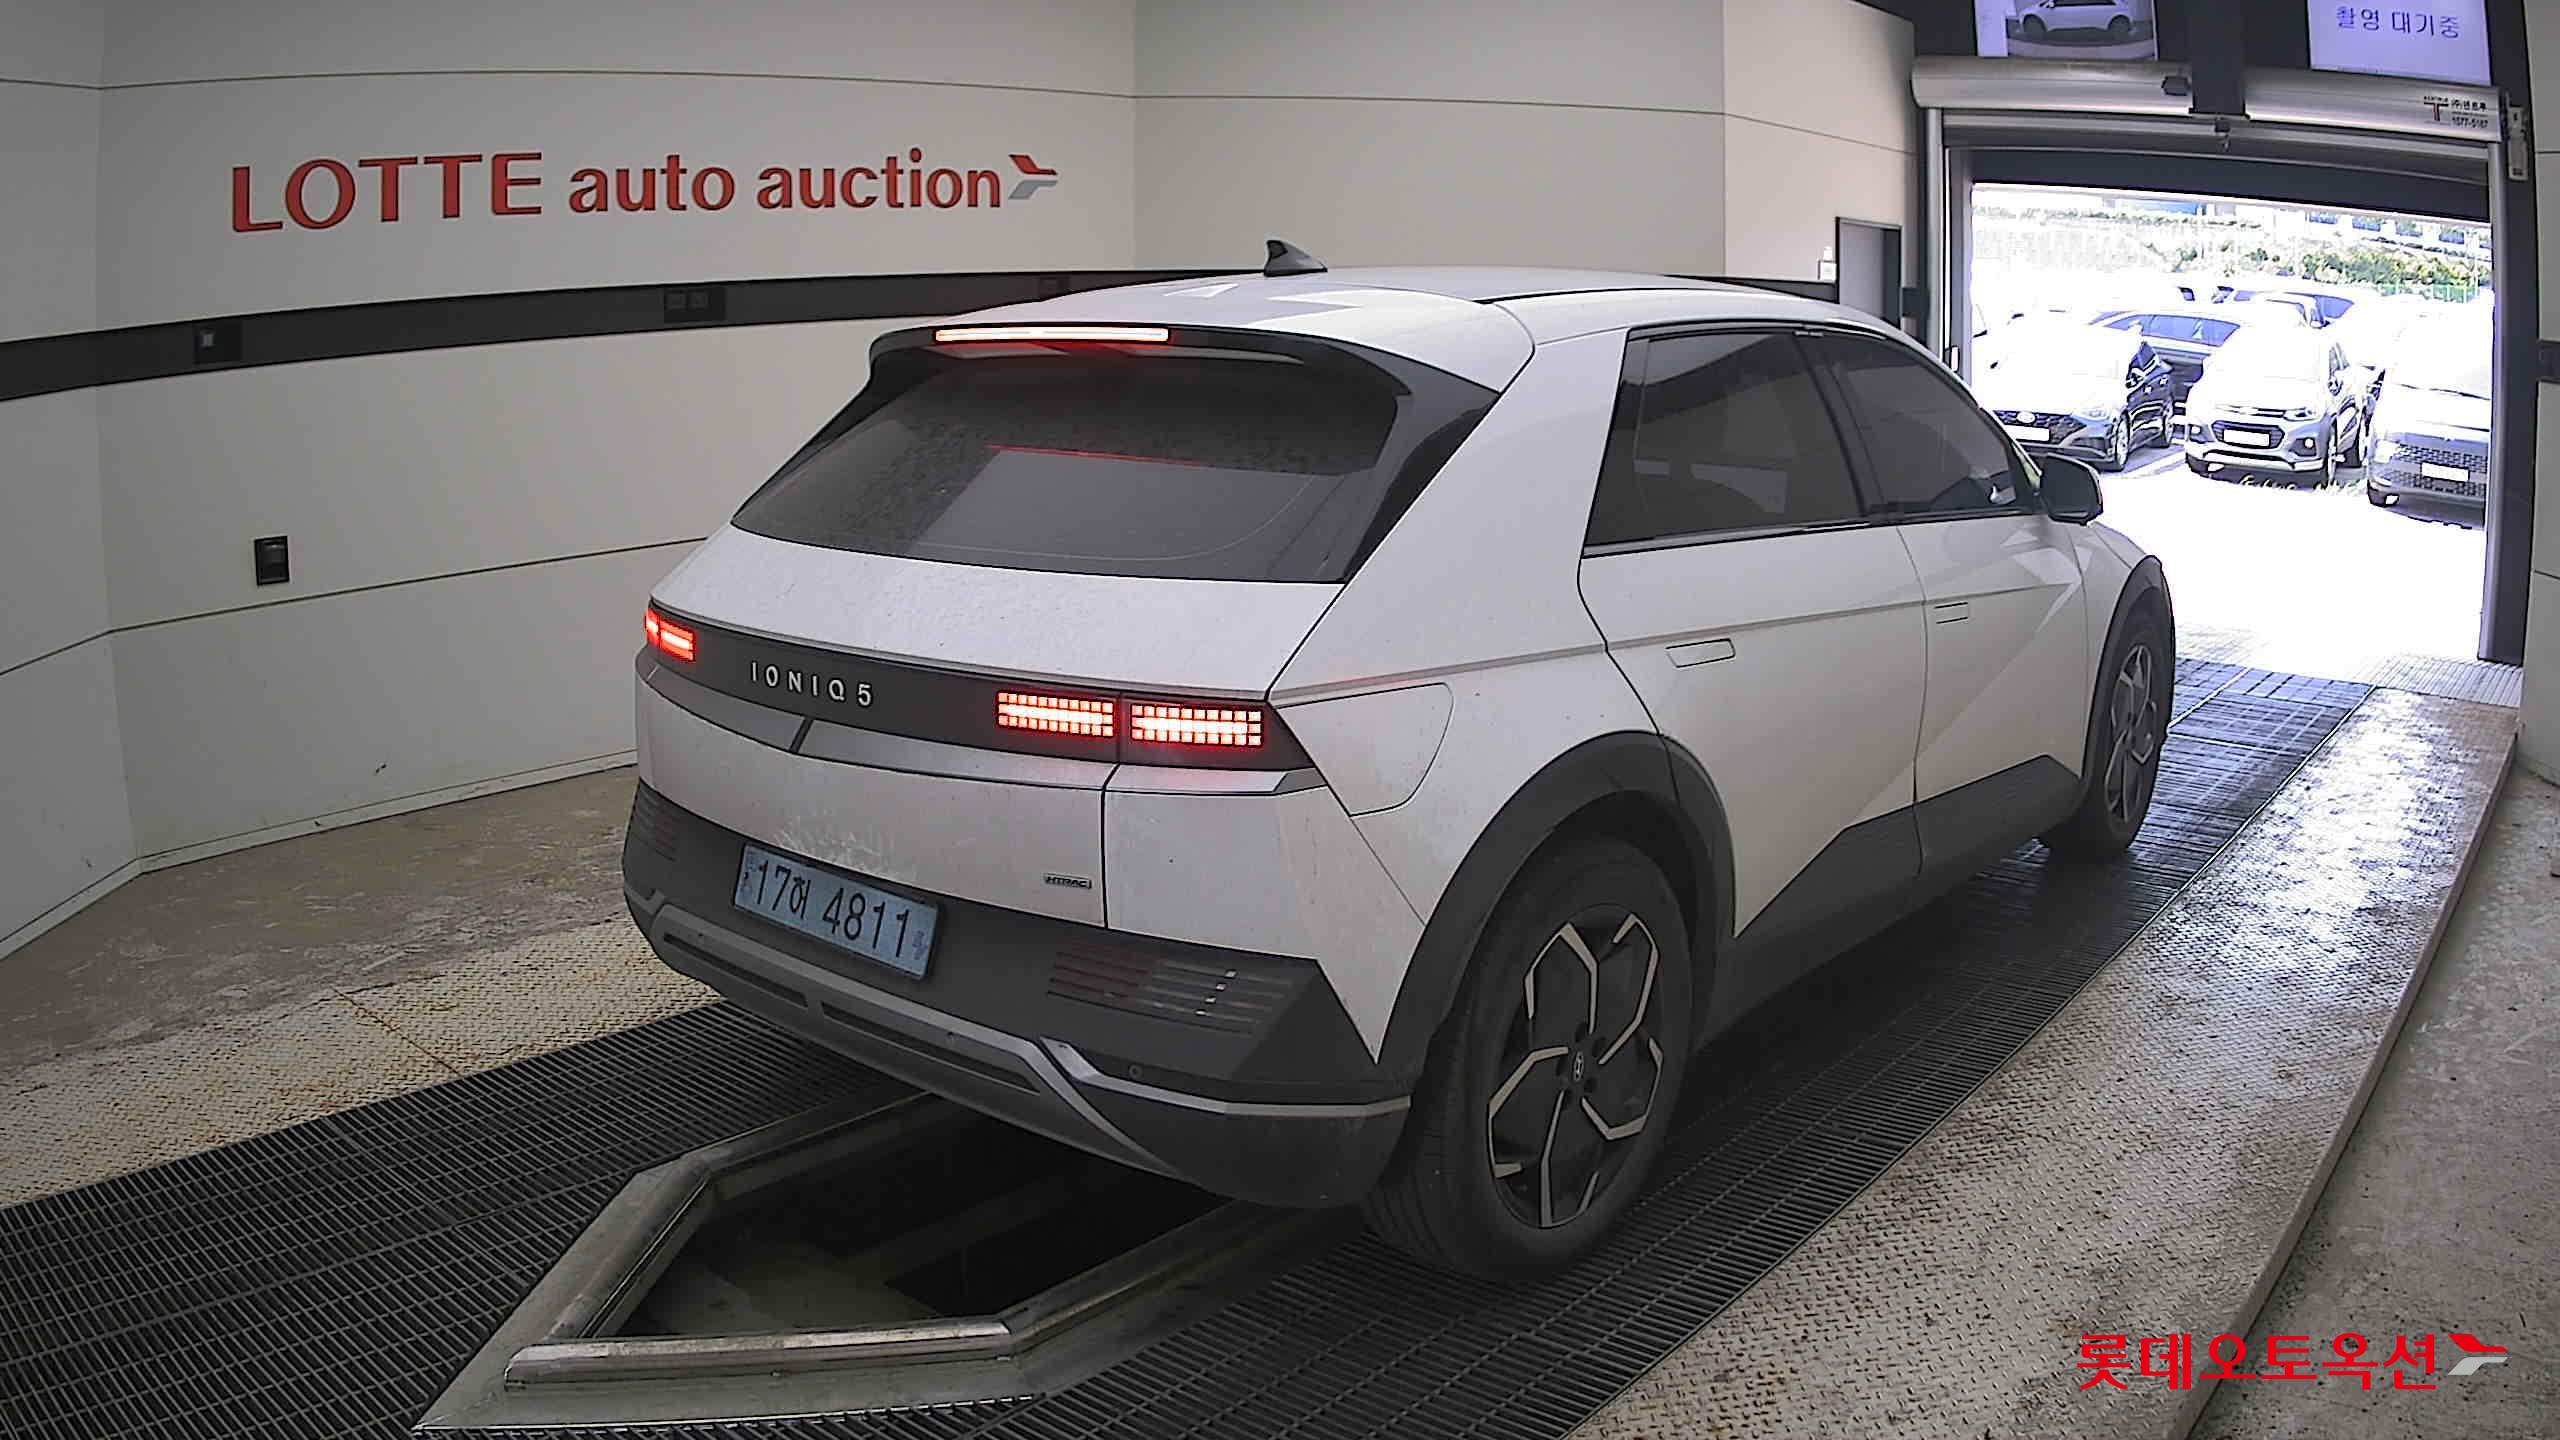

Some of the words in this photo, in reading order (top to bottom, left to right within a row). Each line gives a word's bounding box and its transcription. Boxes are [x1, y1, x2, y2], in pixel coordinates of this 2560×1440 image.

[2337, 5, 2381, 31] 촬영
[2391, 11, 2460, 39] 대기중
[233, 152, 542, 233] LOTTE
[568, 154, 736, 212] auto
[756, 147, 1003, 210] auction
[757, 860, 812, 920] 17허
[822, 886, 910, 958] 4811
